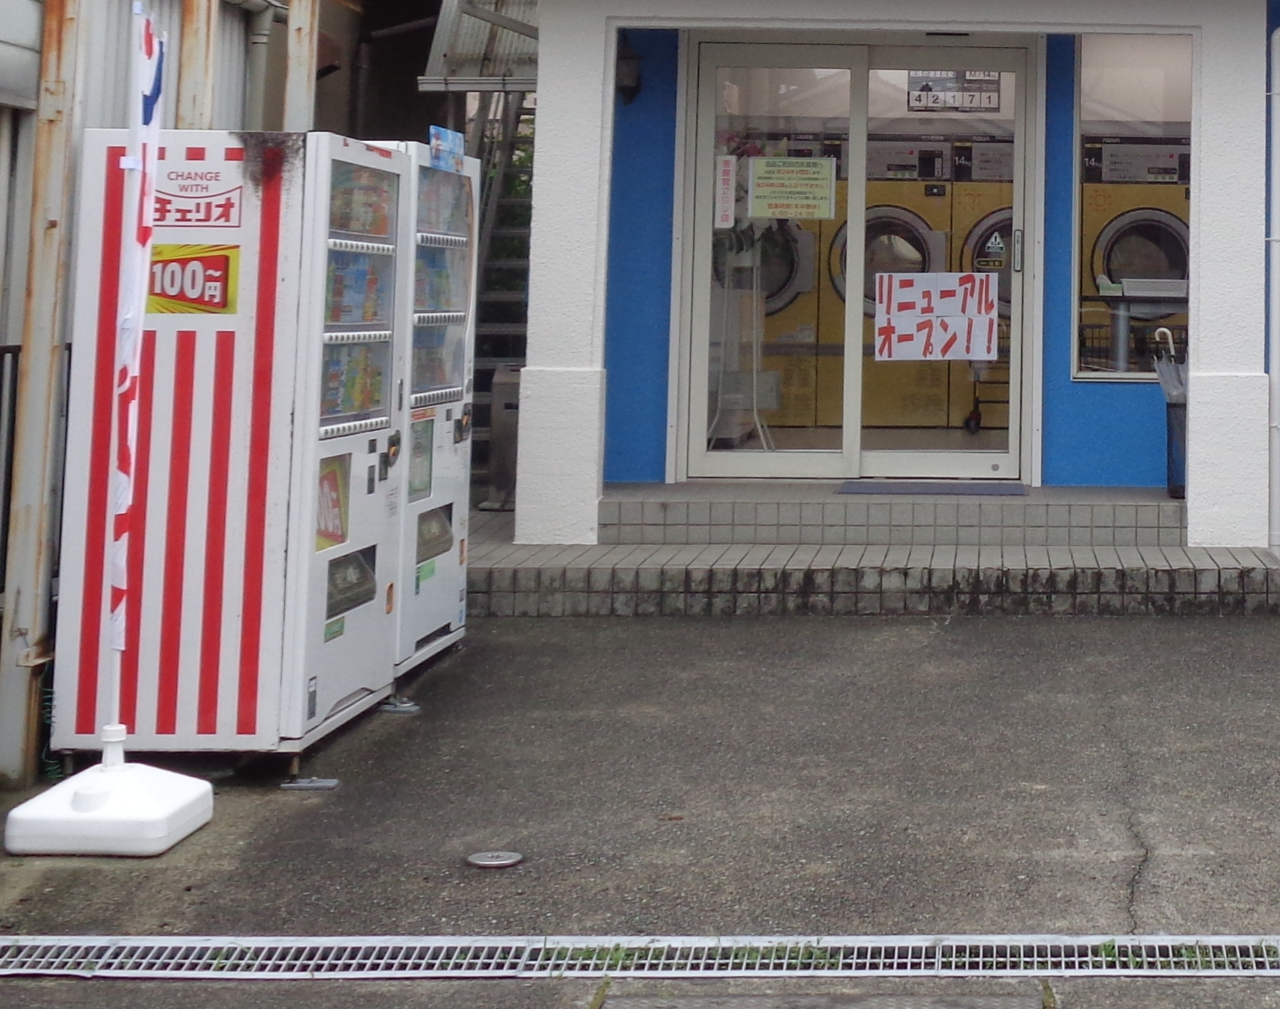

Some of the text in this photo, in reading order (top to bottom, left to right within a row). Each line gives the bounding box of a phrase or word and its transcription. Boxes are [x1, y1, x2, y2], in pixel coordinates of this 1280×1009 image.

[167, 171, 221, 182] CHANGE
[178, 183, 209, 193] WITH
[153, 196, 235, 223] チェリオ
[878, 274, 995, 315] リニューアル
